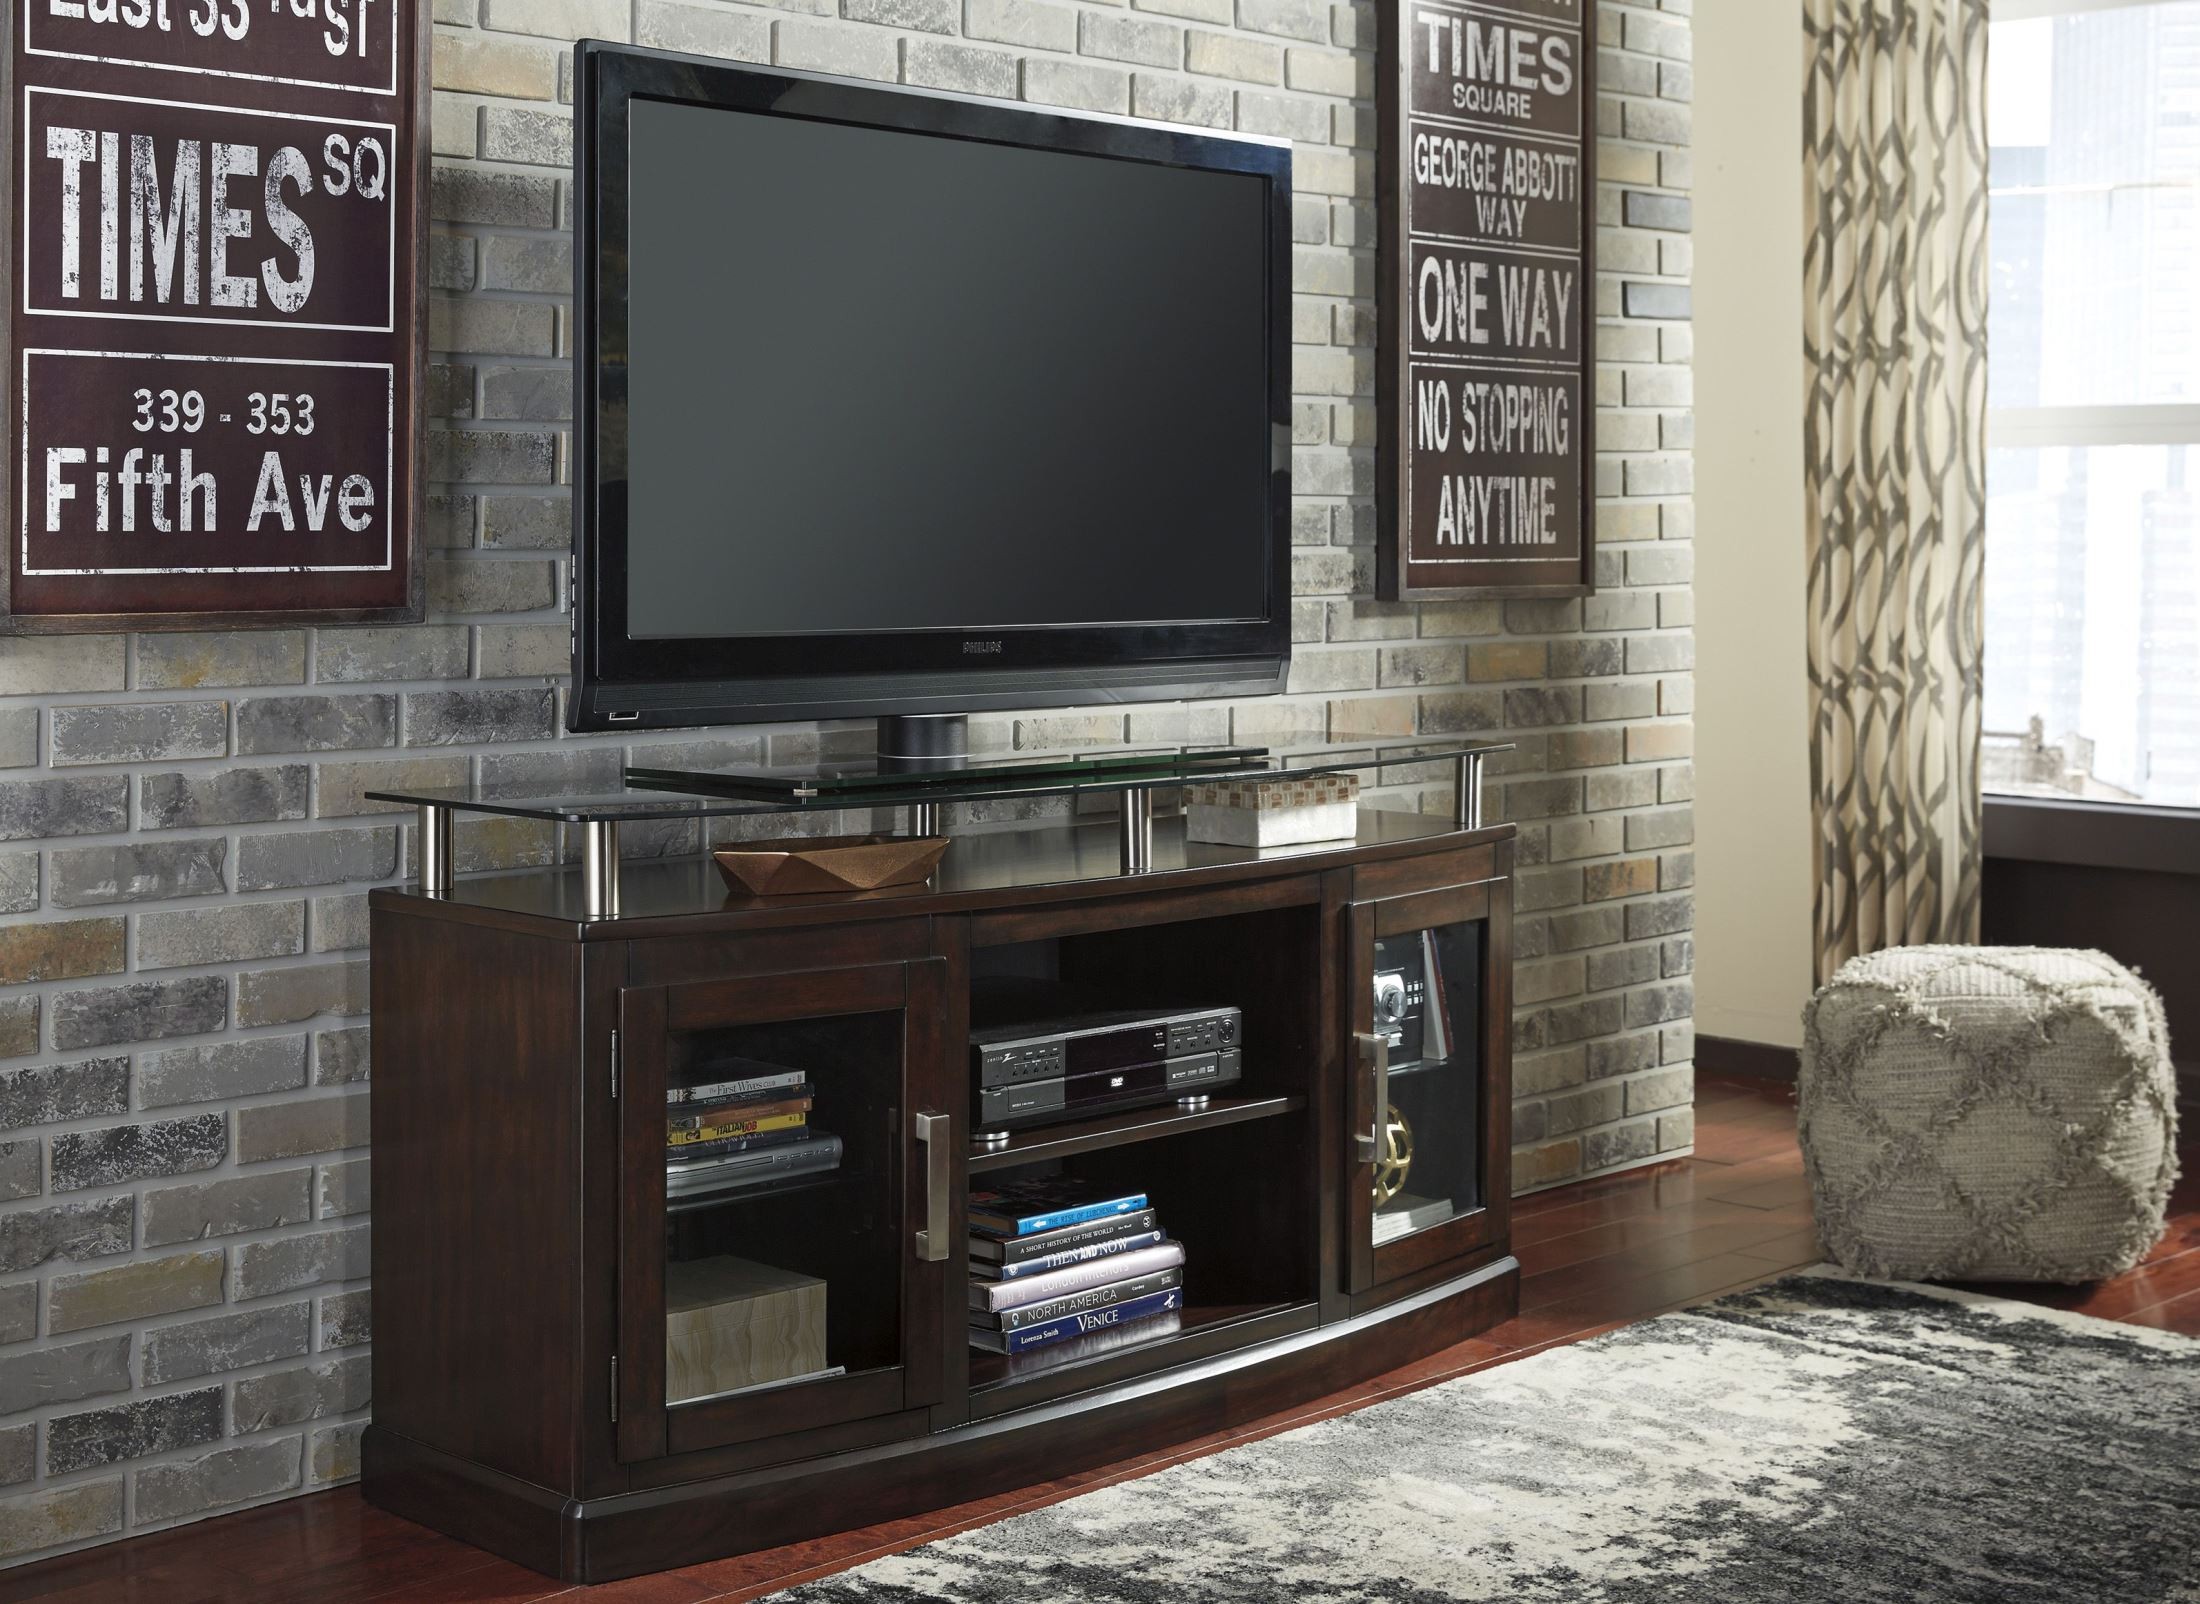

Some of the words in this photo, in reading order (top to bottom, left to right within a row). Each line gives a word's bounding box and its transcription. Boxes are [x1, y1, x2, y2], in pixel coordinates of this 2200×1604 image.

[1417, 11, 1573, 96] TIMES
[1453, 82, 1532, 119] SQUARE
[1414, 133, 1497, 193] GEORGE
[1501, 146, 1577, 202] ABBOTT
[45, 127, 317, 314] TIMES
[323, 133, 386, 201] SQ
[1475, 195, 1527, 238] WAY
[1419, 256, 1489, 344] ONE
[1499, 265, 1572, 350] WAY
[132, 387, 206, 433] 339
[246, 391, 316, 436] 353
[1418, 380, 1451, 453] NO
[1462, 382, 1569, 456] STOPPING
[46, 446, 217, 533] Fifth
[246, 450, 375, 533] Ave
[1436, 475, 1557, 545] ANYTIME
[717, 1083, 737, 1095] First
[738, 1080, 763, 1092] Wives
[1025, 1242, 1046, 1253] SHORT
[1047, 1237, 1072, 1248] HISTORY
[1072, 1234, 1081, 1242] OF
[1081, 1231, 1093, 1240] THE
[1093, 1226, 1114, 1237] WORLD
[1061, 1214, 1074, 1223] RISE
[1044, 1249, 1079, 1268] THEN
[1079, 1244, 1098, 1260] AND
[1098, 1237, 1128, 1255] NOW
[1027, 1304, 1066, 1322] NORTH
[1069, 1289, 1117, 1310] AMERICA
[1077, 1309, 1119, 1332] VENICE
[1020, 1334, 1043, 1345] Lorenza
[1043, 1328, 1060, 1339] Smith
